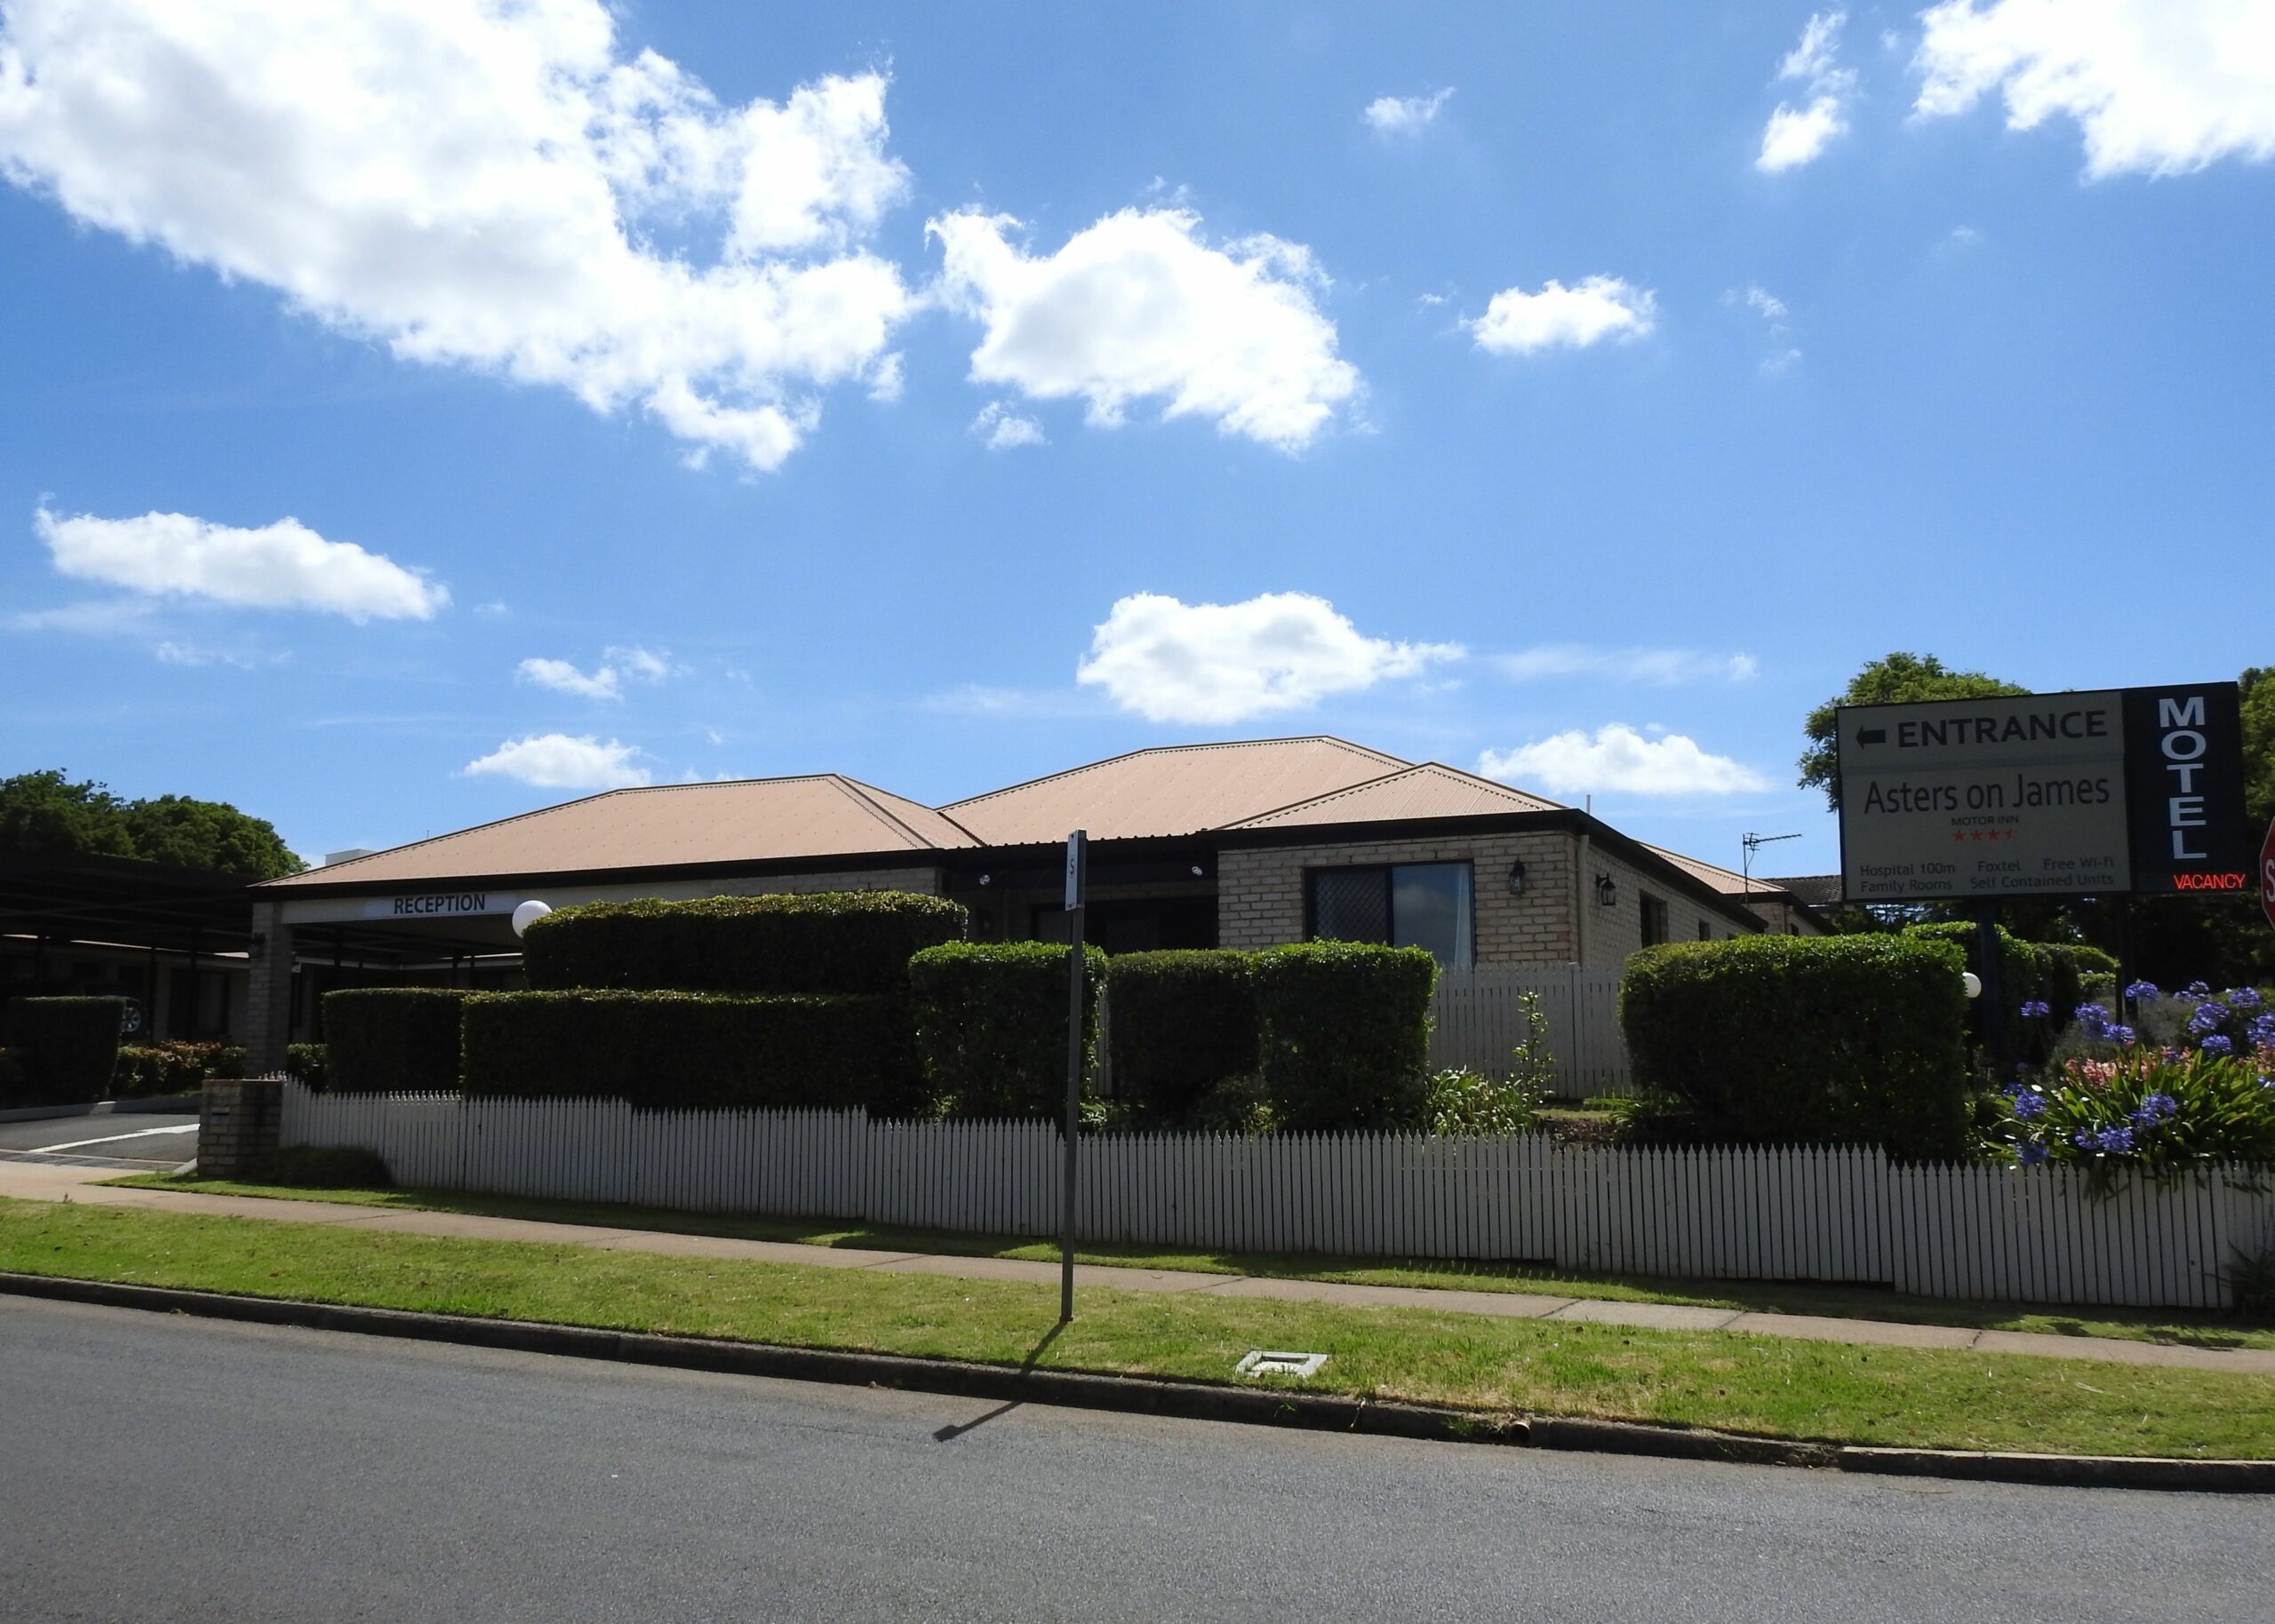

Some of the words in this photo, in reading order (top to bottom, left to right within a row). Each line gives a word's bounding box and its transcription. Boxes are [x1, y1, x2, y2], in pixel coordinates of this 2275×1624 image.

[1897, 711, 2108, 748] ENTRANCE
[2159, 697, 2207, 860] MOTEL
[1864, 781, 1956, 815] Asters
[1967, 784, 2004, 809] on
[2012, 774, 2110, 808] James
[1951, 816, 1995, 826] MOTOR
[1997, 815, 2019, 824] INN
[1859, 864, 1914, 878] Hospital
[1920, 863, 1956, 875] 100m
[1977, 860, 2021, 872] Foxtel
[2043, 858, 2075, 871] Free
[2079, 856, 2114, 869] Wi-fi
[1860, 880, 1904, 895] Family
[1909, 879, 1953, 891] Rooms
[1970, 876, 1997, 889] Self
[2000, 873, 2073, 888] Contained
[2077, 872, 2114, 886] Units
[2173, 873, 2247, 889] VACANCY
[394, 894, 486, 914] RECEPTION
